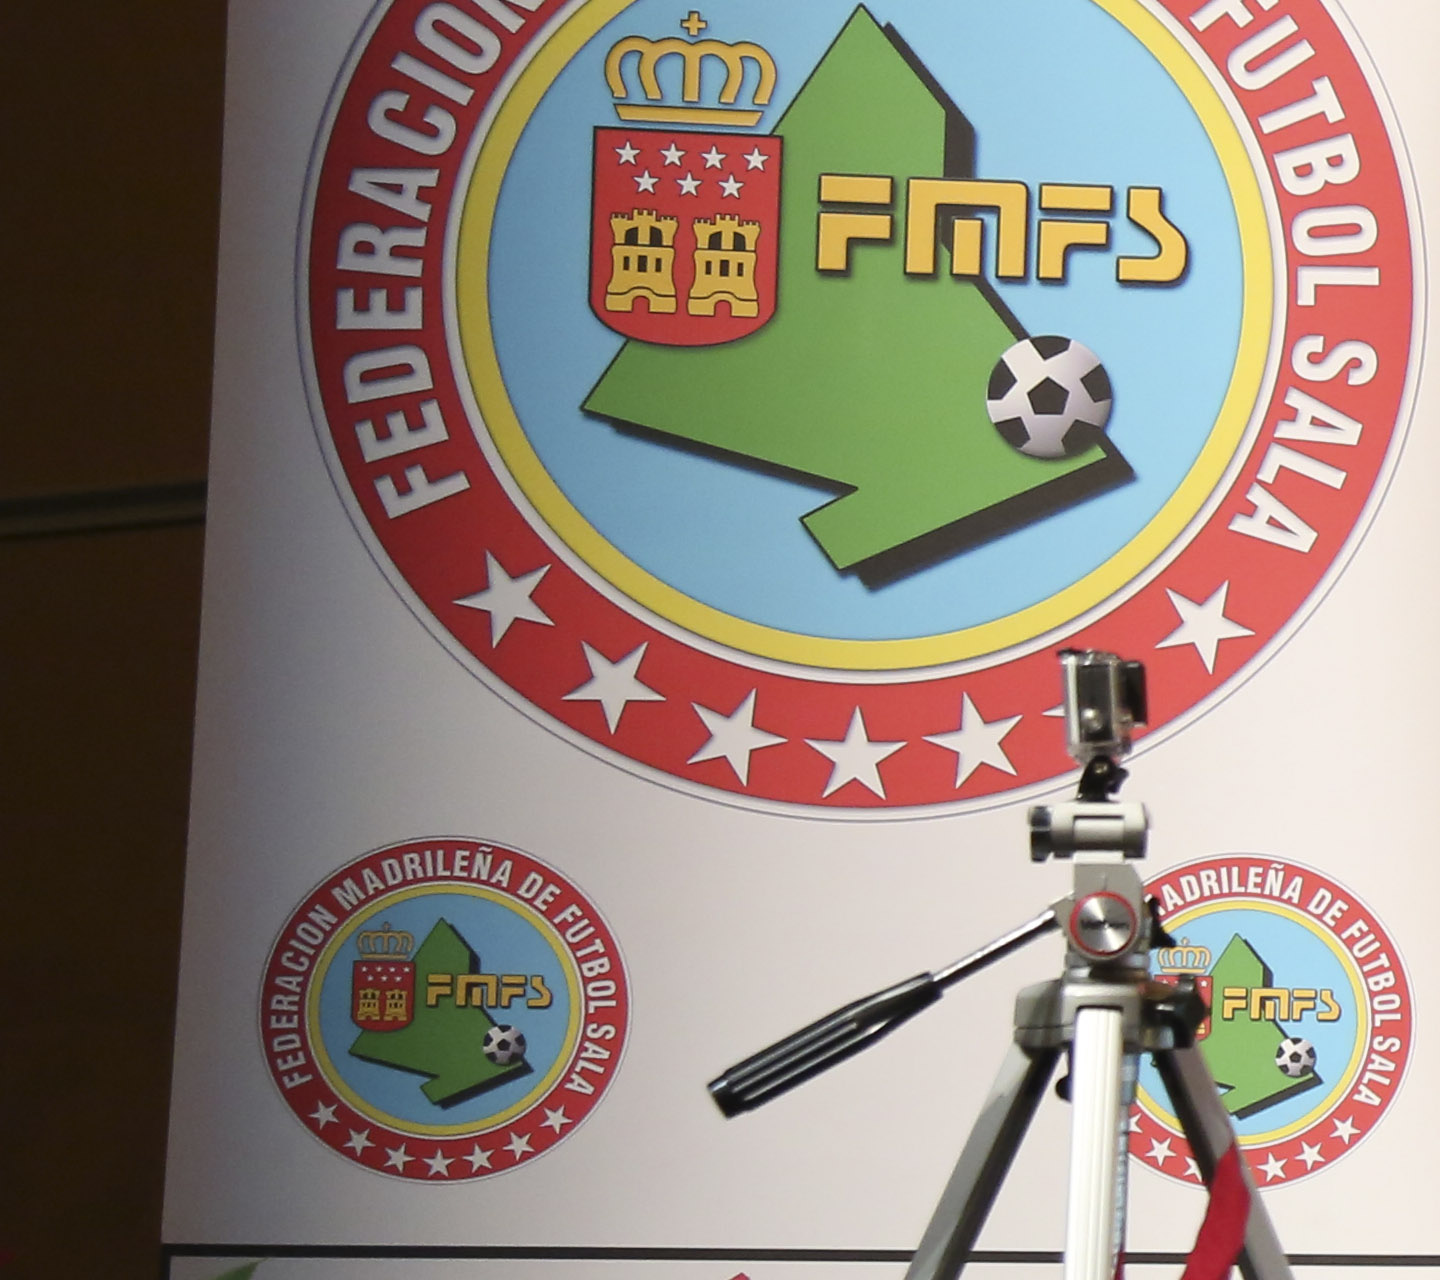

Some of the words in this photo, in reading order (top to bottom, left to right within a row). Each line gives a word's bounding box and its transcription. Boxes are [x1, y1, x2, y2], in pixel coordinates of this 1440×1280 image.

[815, 174, 1193, 287] FMFS
[1228, 334, 1378, 554] SALA
[334, 846, 513, 911] MADRILEÑA
[516, 871, 560, 911] DE
[1307, 888, 1349, 927] DE
[426, 973, 552, 1009] FMFS
[553, 906, 616, 1014] FUTBOL
[1341, 918, 1401, 1027] FUTBOL
[270, 904, 338, 1089] FEDERACION
[1222, 987, 1342, 1022] FMFS
[564, 1024, 615, 1096] SALA
[1352, 1036, 1401, 1108] SALA
